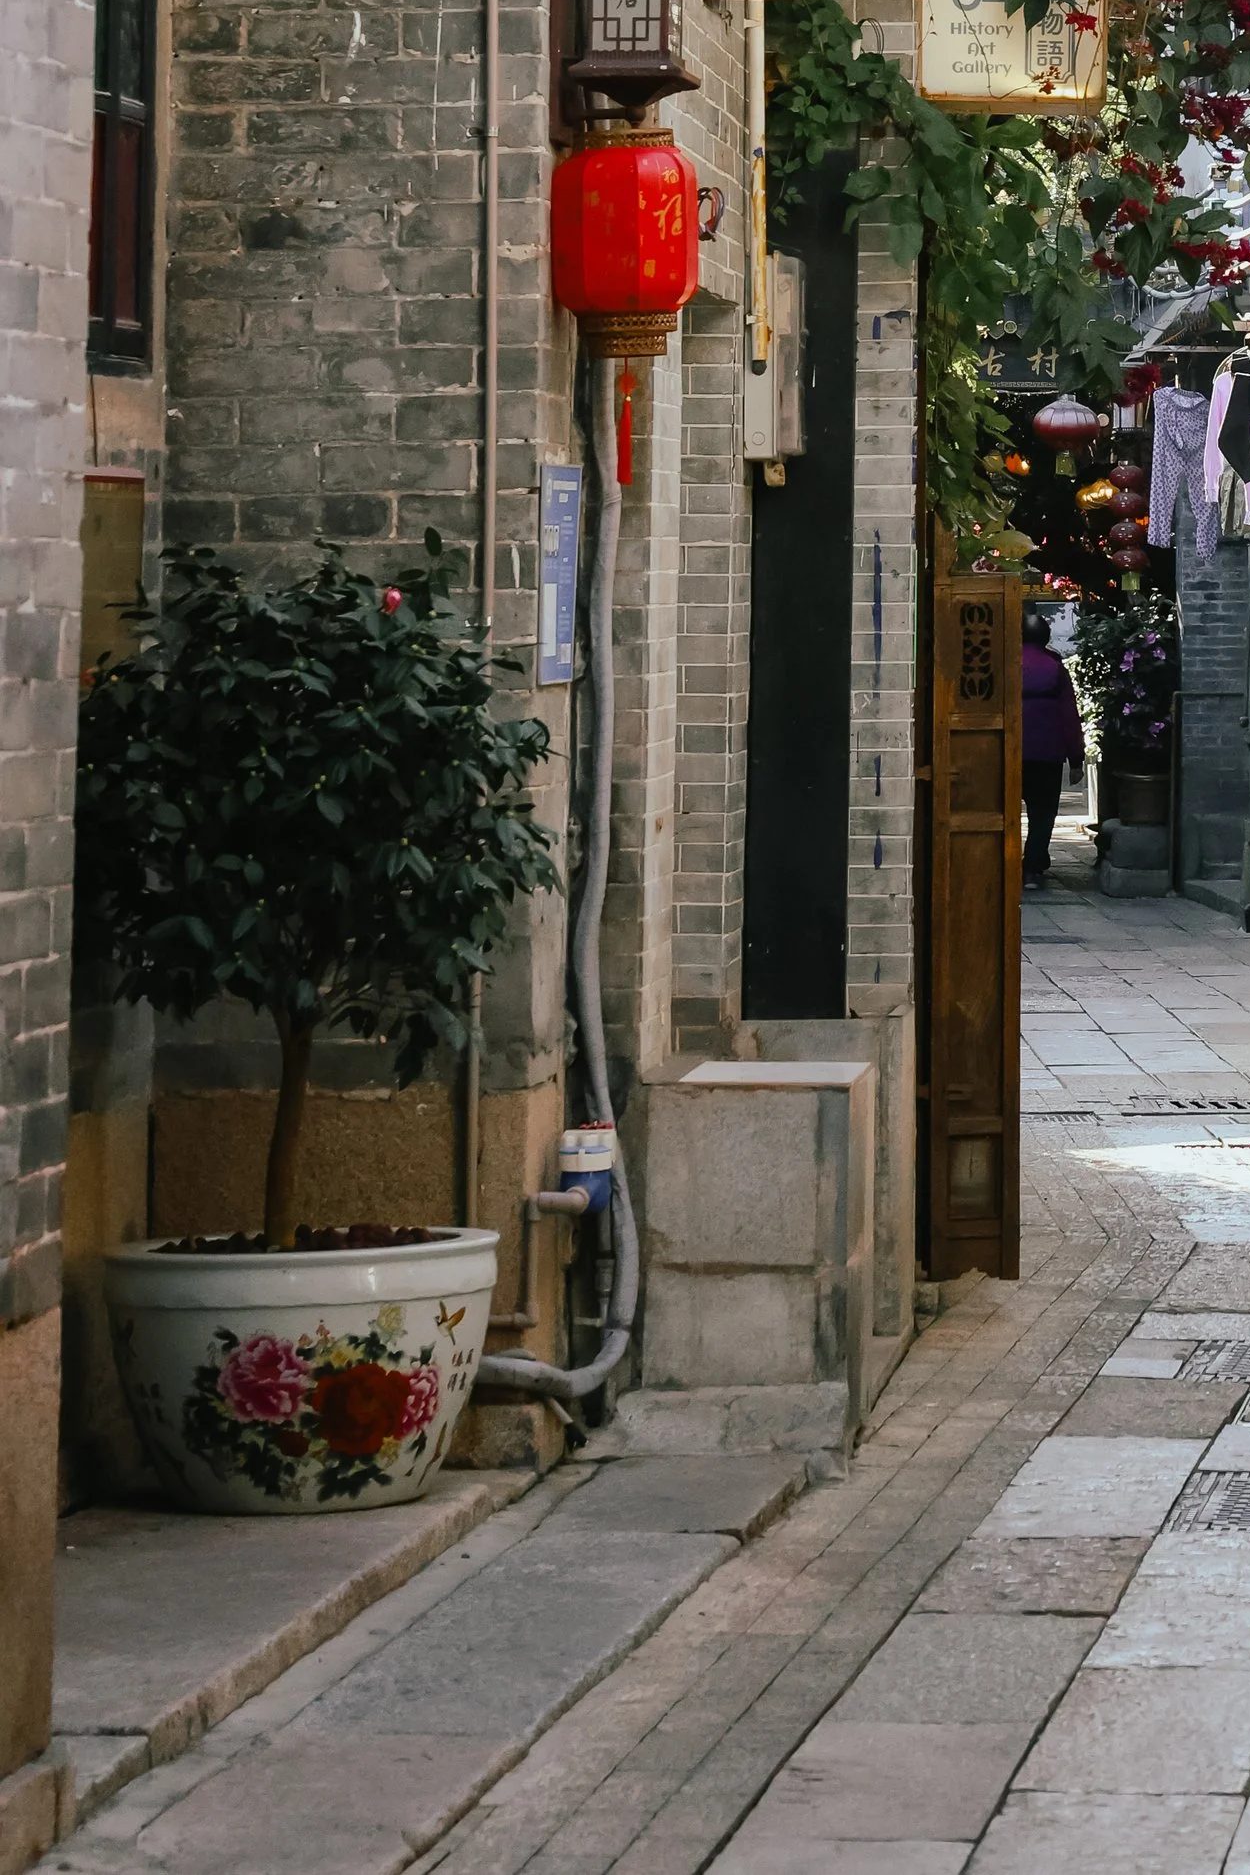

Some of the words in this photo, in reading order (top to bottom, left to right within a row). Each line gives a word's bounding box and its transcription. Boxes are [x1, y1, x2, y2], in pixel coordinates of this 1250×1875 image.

[949, 21, 1014, 40] History
[966, 41, 997, 56] Art
[951, 60, 1012, 80] Gallery
[975, 345, 1060, 379] 古村
